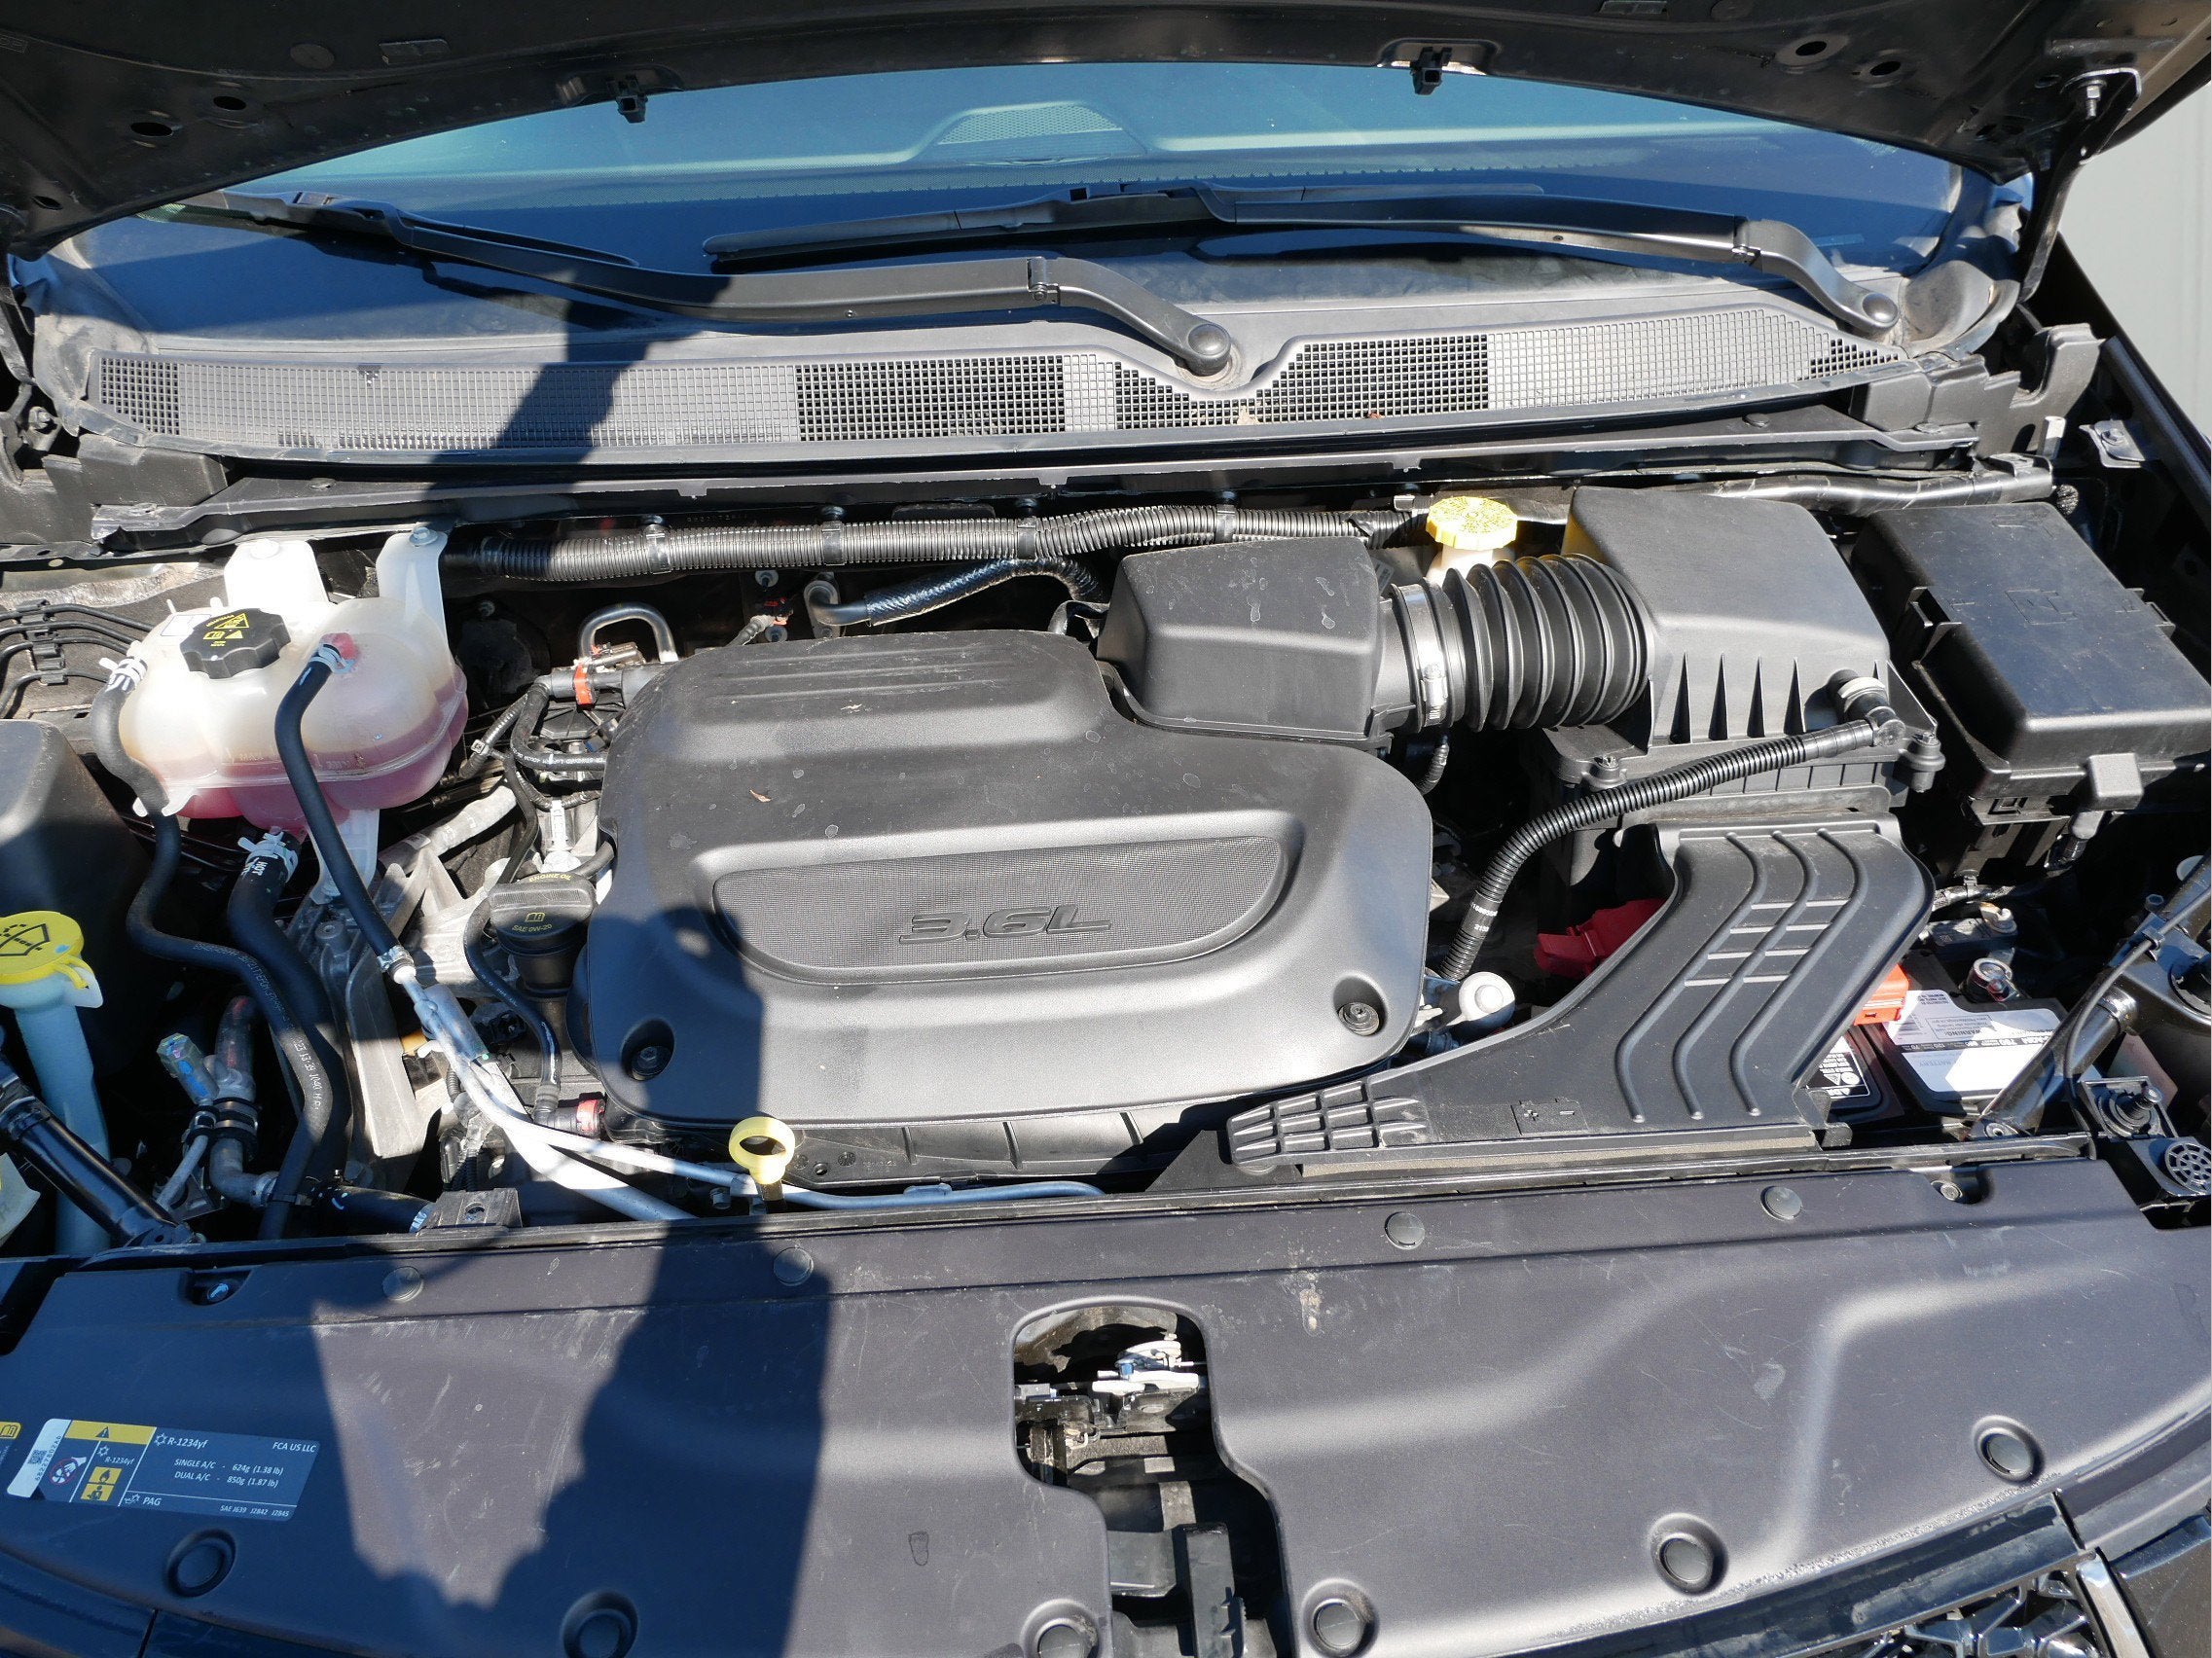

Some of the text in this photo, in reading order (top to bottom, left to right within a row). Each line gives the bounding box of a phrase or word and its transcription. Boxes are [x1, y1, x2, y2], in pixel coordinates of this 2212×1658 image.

[528, 873, 573, 883] ENGINE OIL
[528, 923, 553, 933] 0W-20
[898, 904, 1112, 945] 3.6L
[166, 1437, 208, 1449] R-1234yf
[272, 1441, 288, 1451] FCA
[302, 1444, 316, 1453] LLC
[104, 1456, 135, 1465] R-1234yf
[174, 1459, 200, 1468] SINGLE
[200, 1460, 216, 1469] A/C
[232, 1463, 251, 1473] 624g
[253, 1464, 272, 1474] (1.38
[272, 1466, 283, 1475] lb)
[174, 1471, 195, 1480] DUAL
[196, 1472, 210, 1481] A/C
[227, 1475, 245, 1486] 850g
[247, 1477, 267, 1487] (1.87
[268, 1479, 278, 1489] lb)
[142, 1496, 162, 1506] PAG
